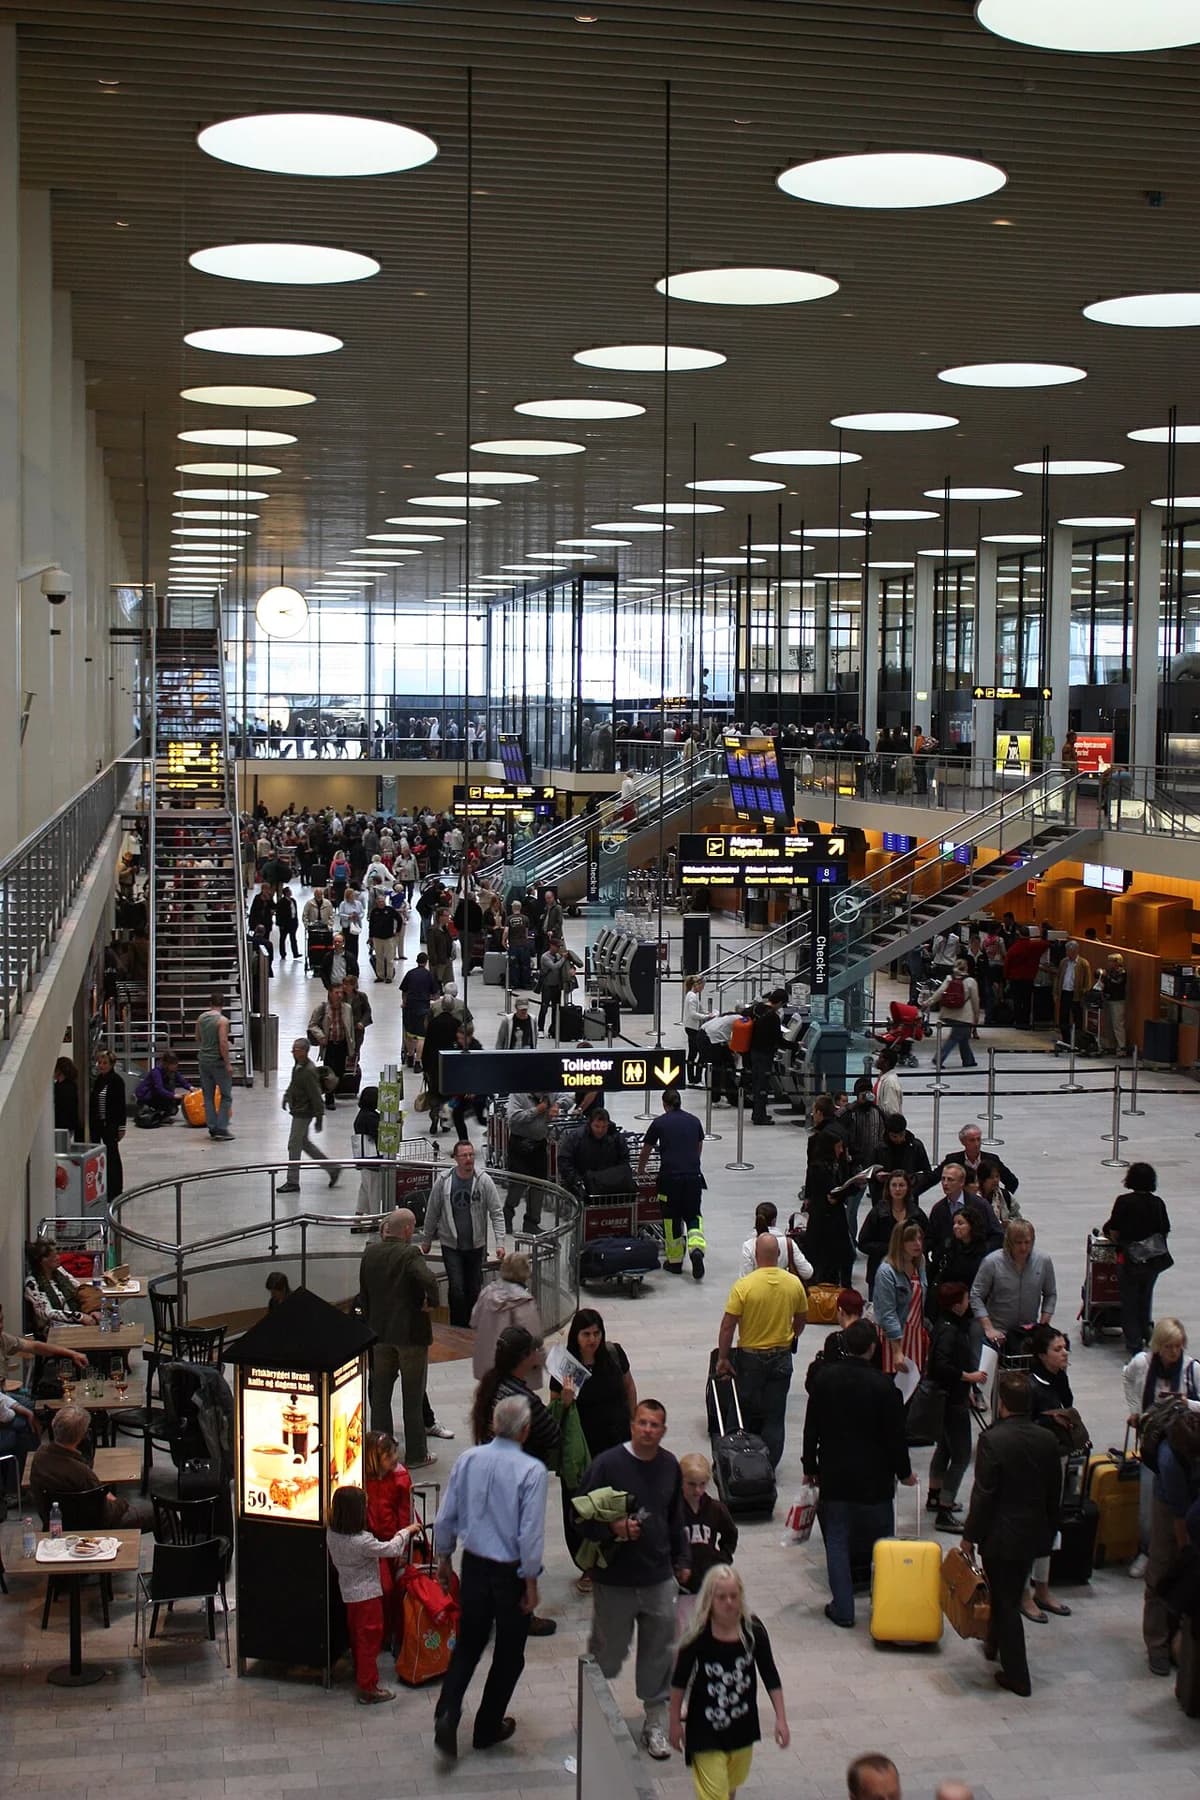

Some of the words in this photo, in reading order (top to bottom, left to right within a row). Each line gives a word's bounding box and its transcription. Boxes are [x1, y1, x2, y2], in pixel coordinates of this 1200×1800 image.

[729, 836, 763, 848] Afgang
[729, 847, 780, 858] Departures
[590, 861, 598, 894] Check-in
[823, 868, 830, 877] 8
[816, 935, 827, 984] Check-in
[561, 1058, 614, 1071] Toiletter
[561, 1073, 603, 1086] Toilets
